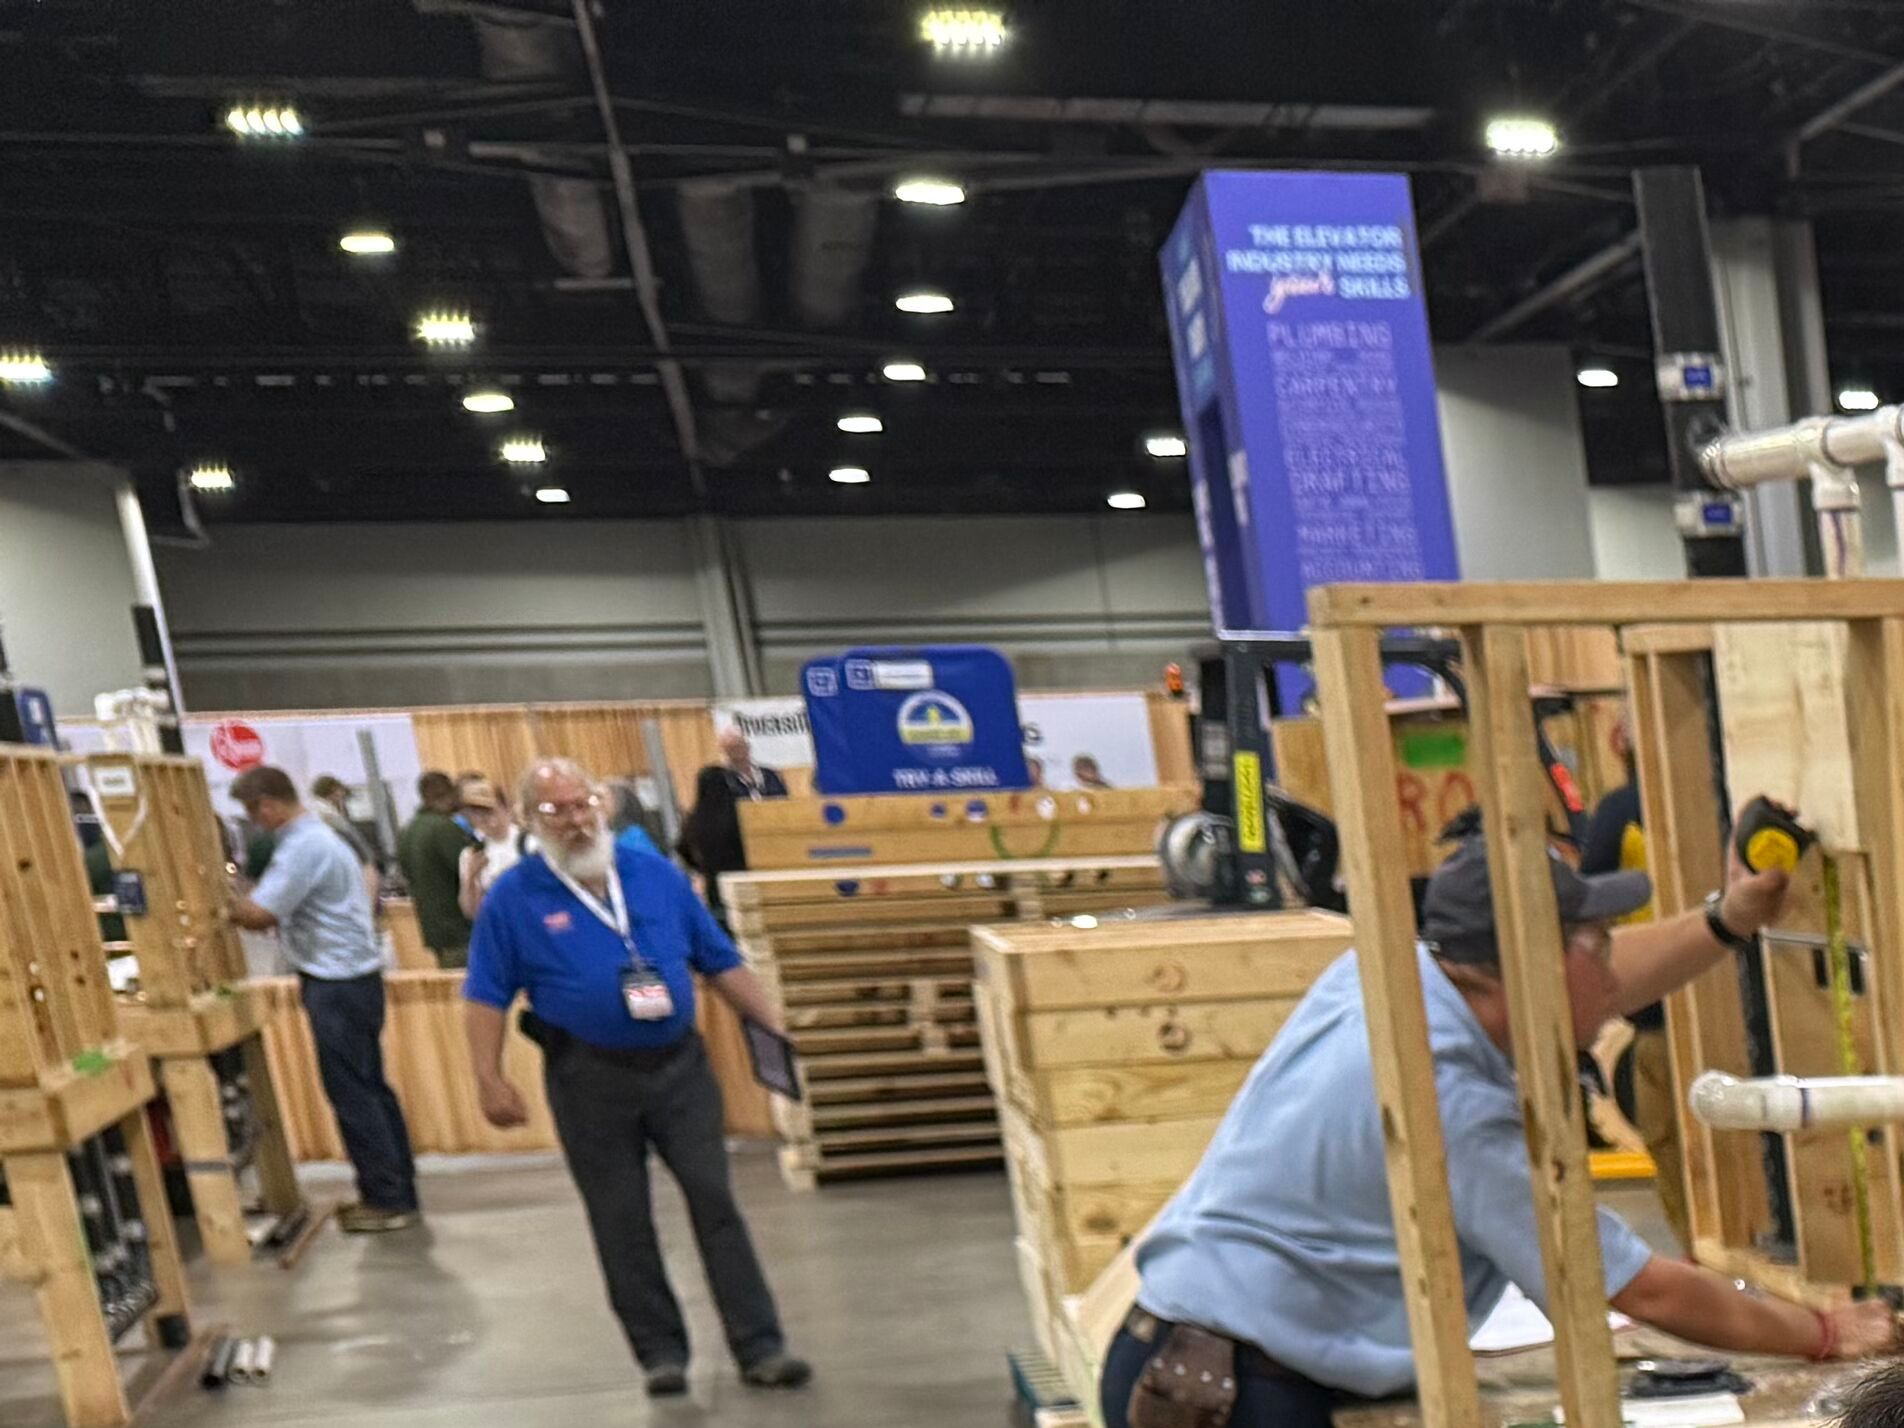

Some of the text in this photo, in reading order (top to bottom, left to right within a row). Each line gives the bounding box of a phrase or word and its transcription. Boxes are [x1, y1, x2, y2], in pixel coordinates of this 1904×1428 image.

[1249, 224, 1403, 248] THE ELEVATOR
[1226, 249, 1407, 273] INDUSTRY NEEDS
[1338, 275, 1411, 299] SKILLS
